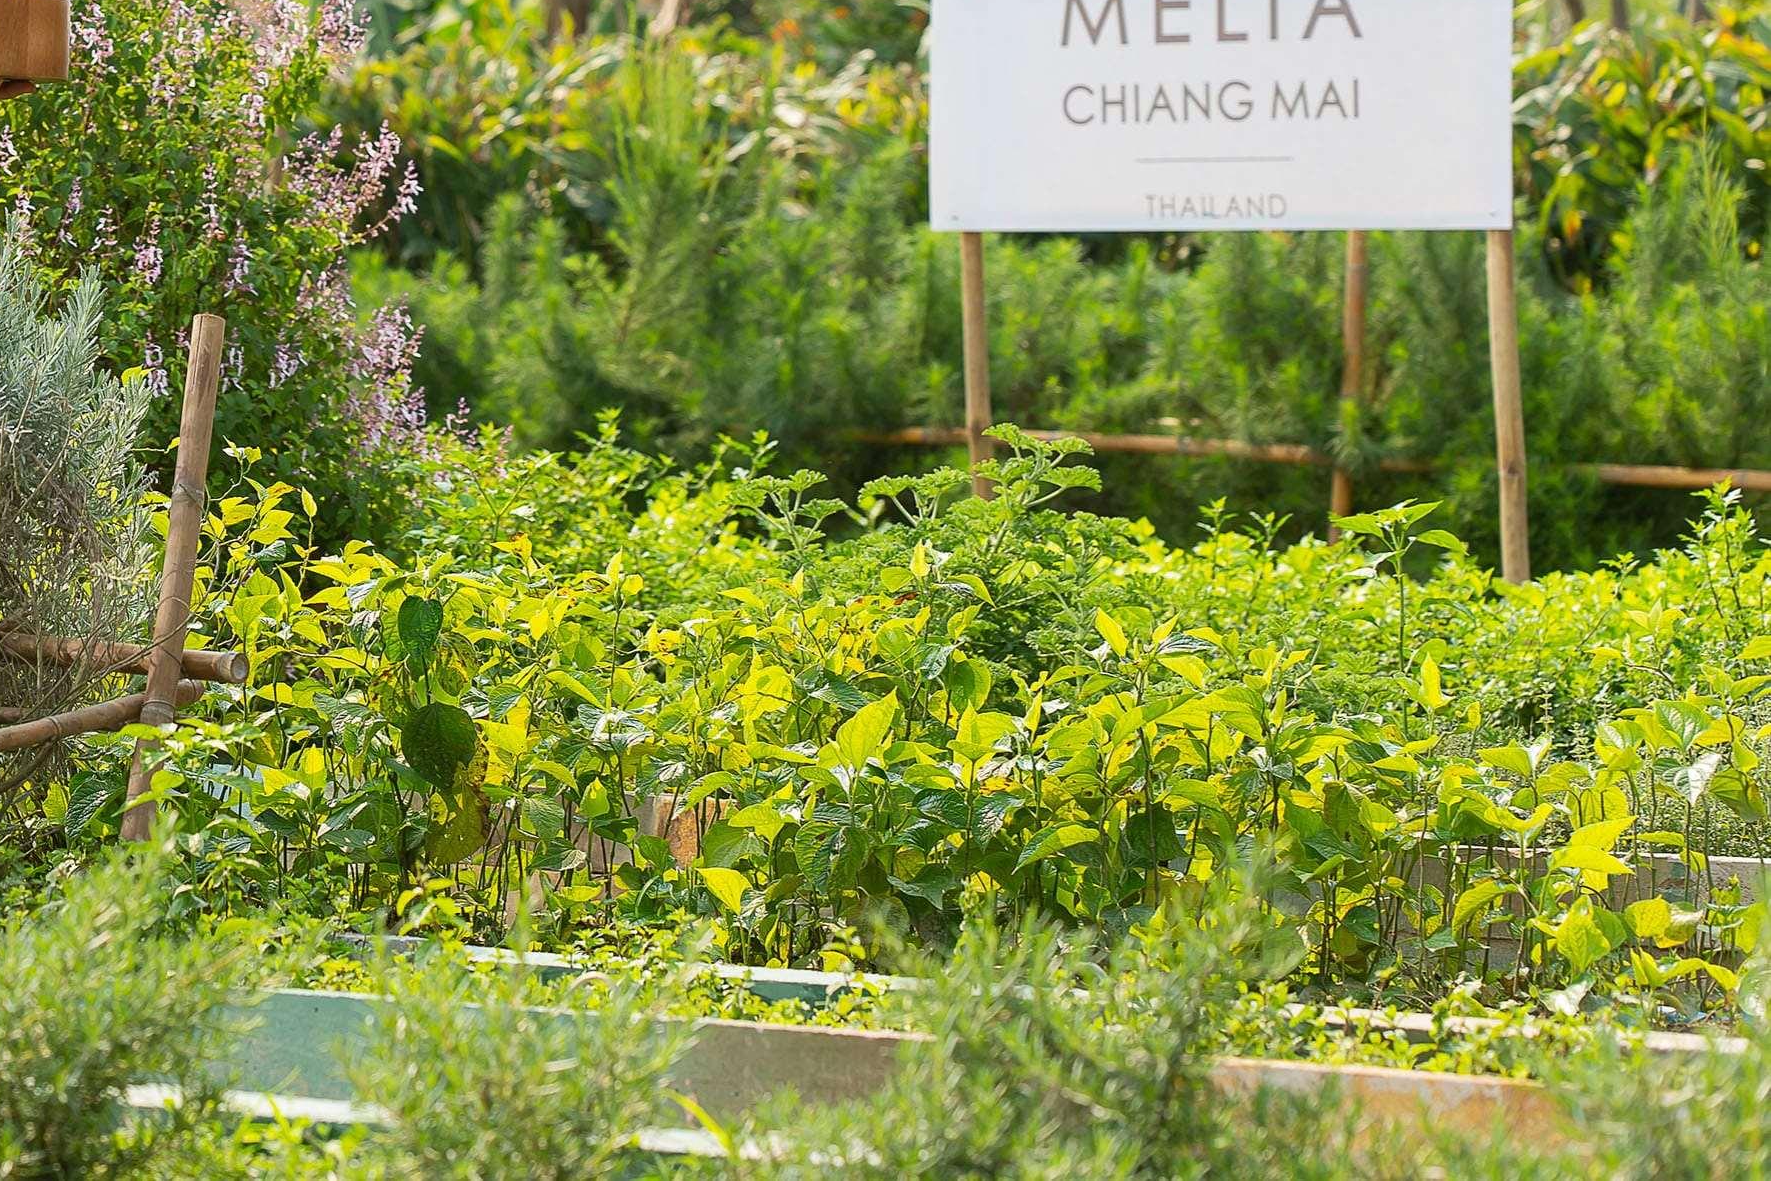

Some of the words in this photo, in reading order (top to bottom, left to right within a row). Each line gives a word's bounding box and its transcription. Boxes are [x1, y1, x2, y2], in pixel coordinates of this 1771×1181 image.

[1062, 80, 1255, 126] CHIANG
[1270, 78, 1361, 120] MAI
[1145, 194, 1288, 220] THAILAND
